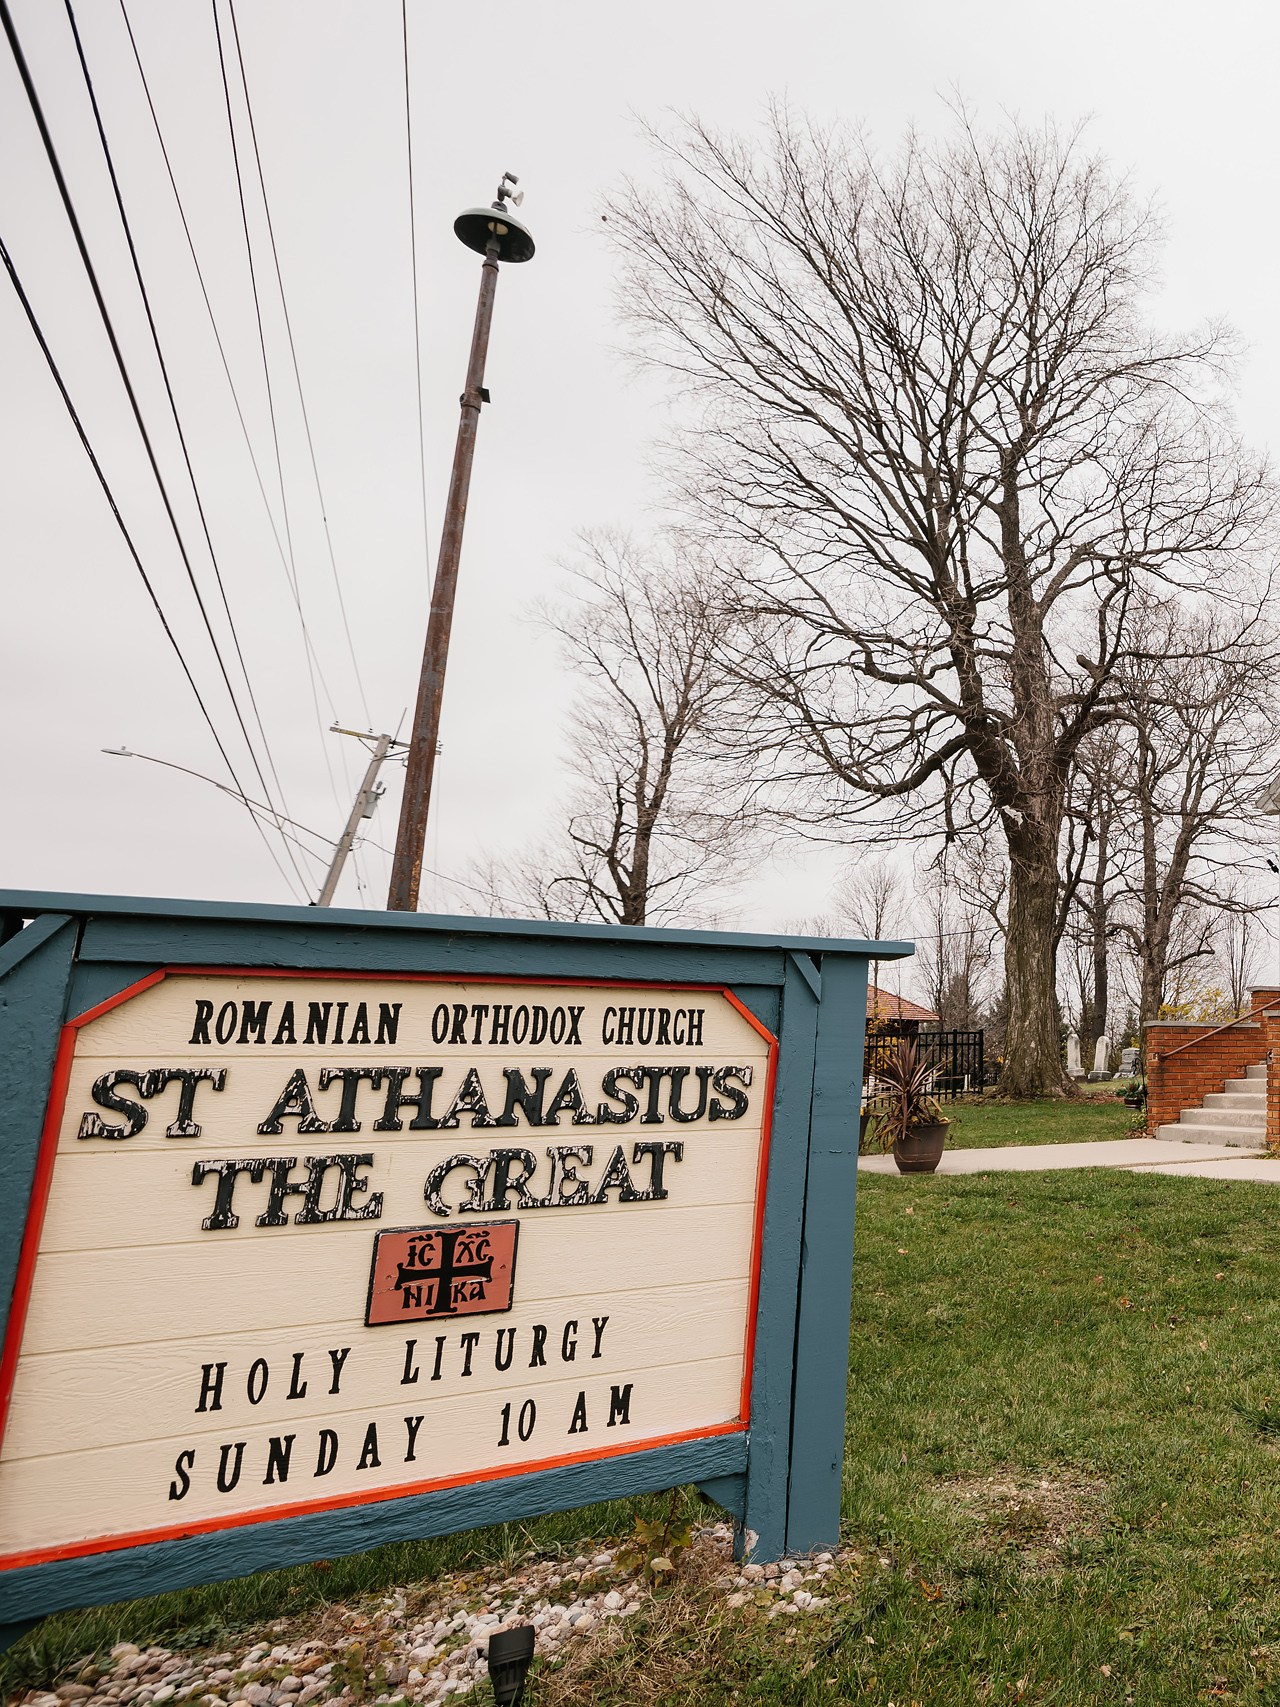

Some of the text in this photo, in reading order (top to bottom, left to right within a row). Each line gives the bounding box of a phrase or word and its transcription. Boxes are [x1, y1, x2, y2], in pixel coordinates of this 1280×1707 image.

[189, 1000, 705, 1045] ROMANIAN ORTHODOX CHURCH
[77, 1066, 753, 1141] ST ATHANASIUS
[191, 1142, 683, 1229] THE GREAT
[195, 1316, 610, 1413] HOLY LITURGY
[169, 1384, 633, 1501] SUNDAY 10 AM
